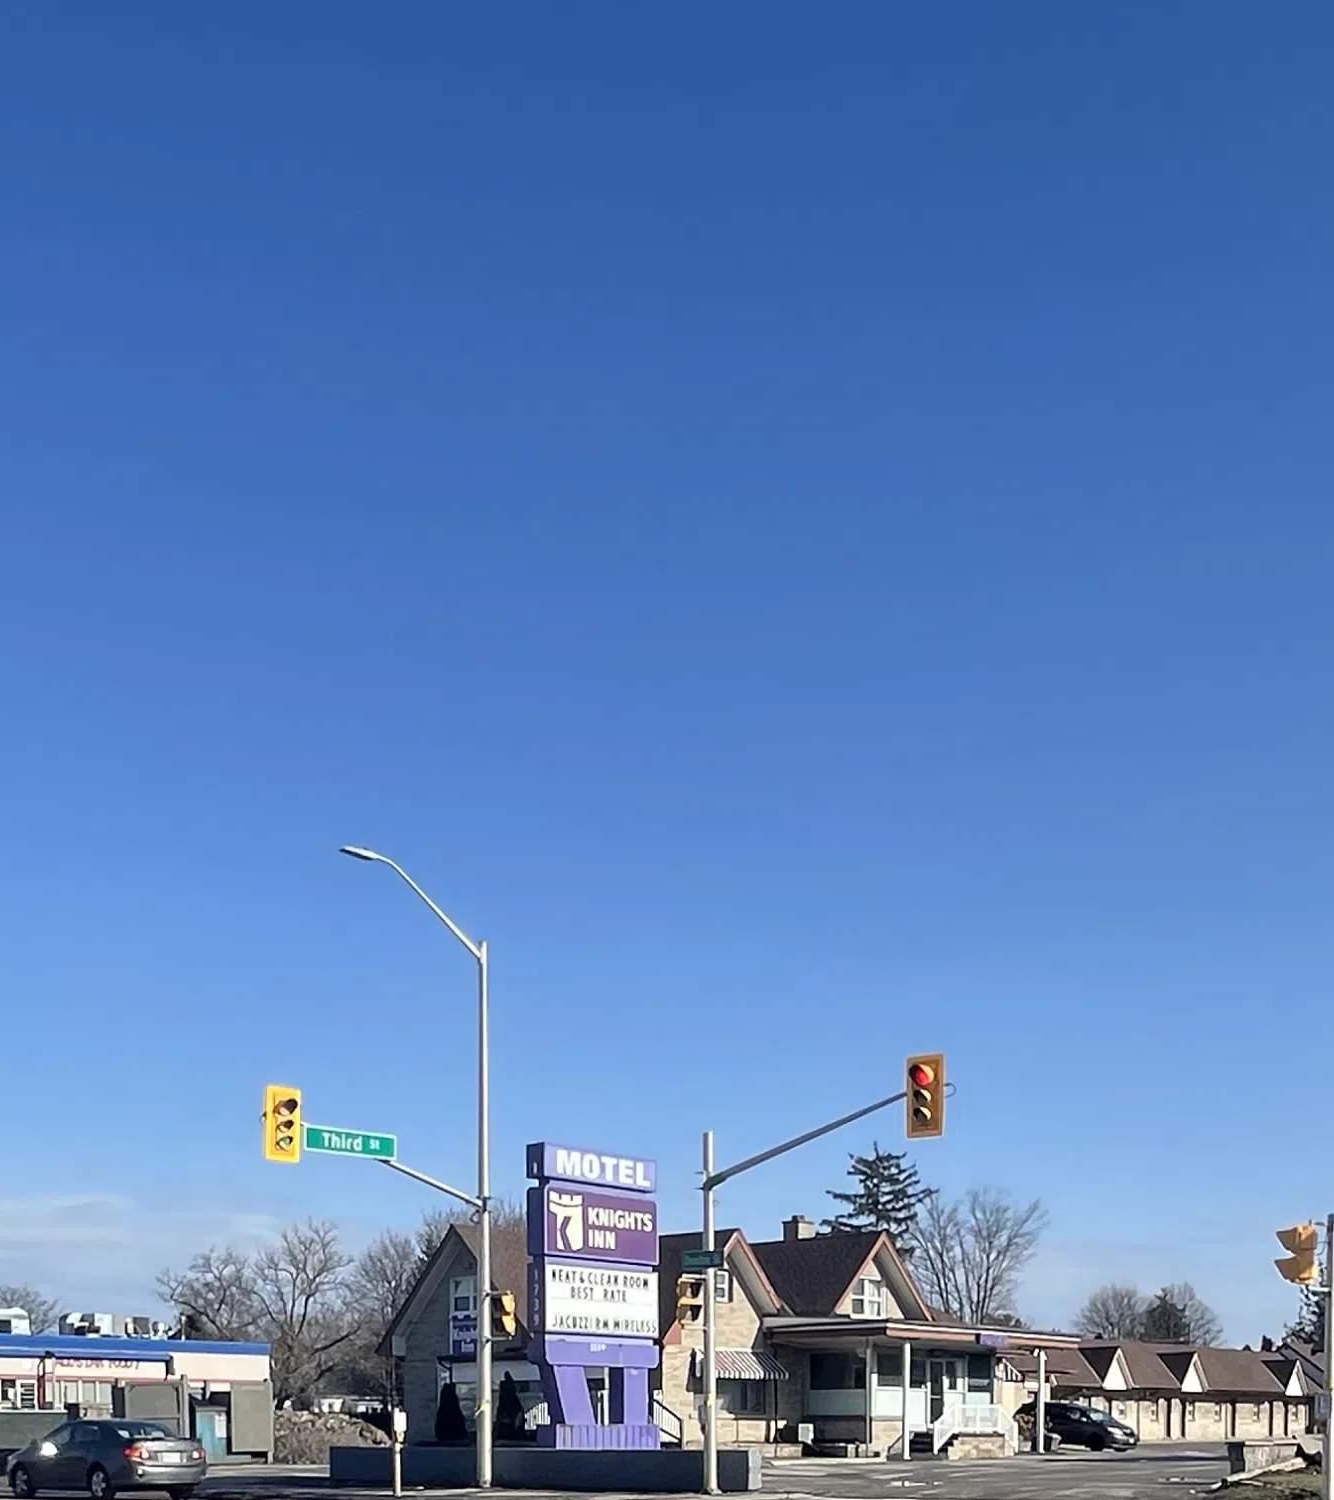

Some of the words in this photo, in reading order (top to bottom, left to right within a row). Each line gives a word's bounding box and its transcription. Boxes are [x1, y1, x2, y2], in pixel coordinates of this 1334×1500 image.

[321, 1132, 363, 1151] Third
[369, 1139, 381, 1150] St
[556, 1149, 651, 1188] MOTEL
[587, 1206, 653, 1232] KNIGHTS
[588, 1229, 616, 1250] INN
[623, 1275, 649, 1289] ROOM
[571, 1286, 594, 1300] BEST
[603, 1289, 627, 1303] RATE
[613, 1317, 657, 1333] WIRELESS
